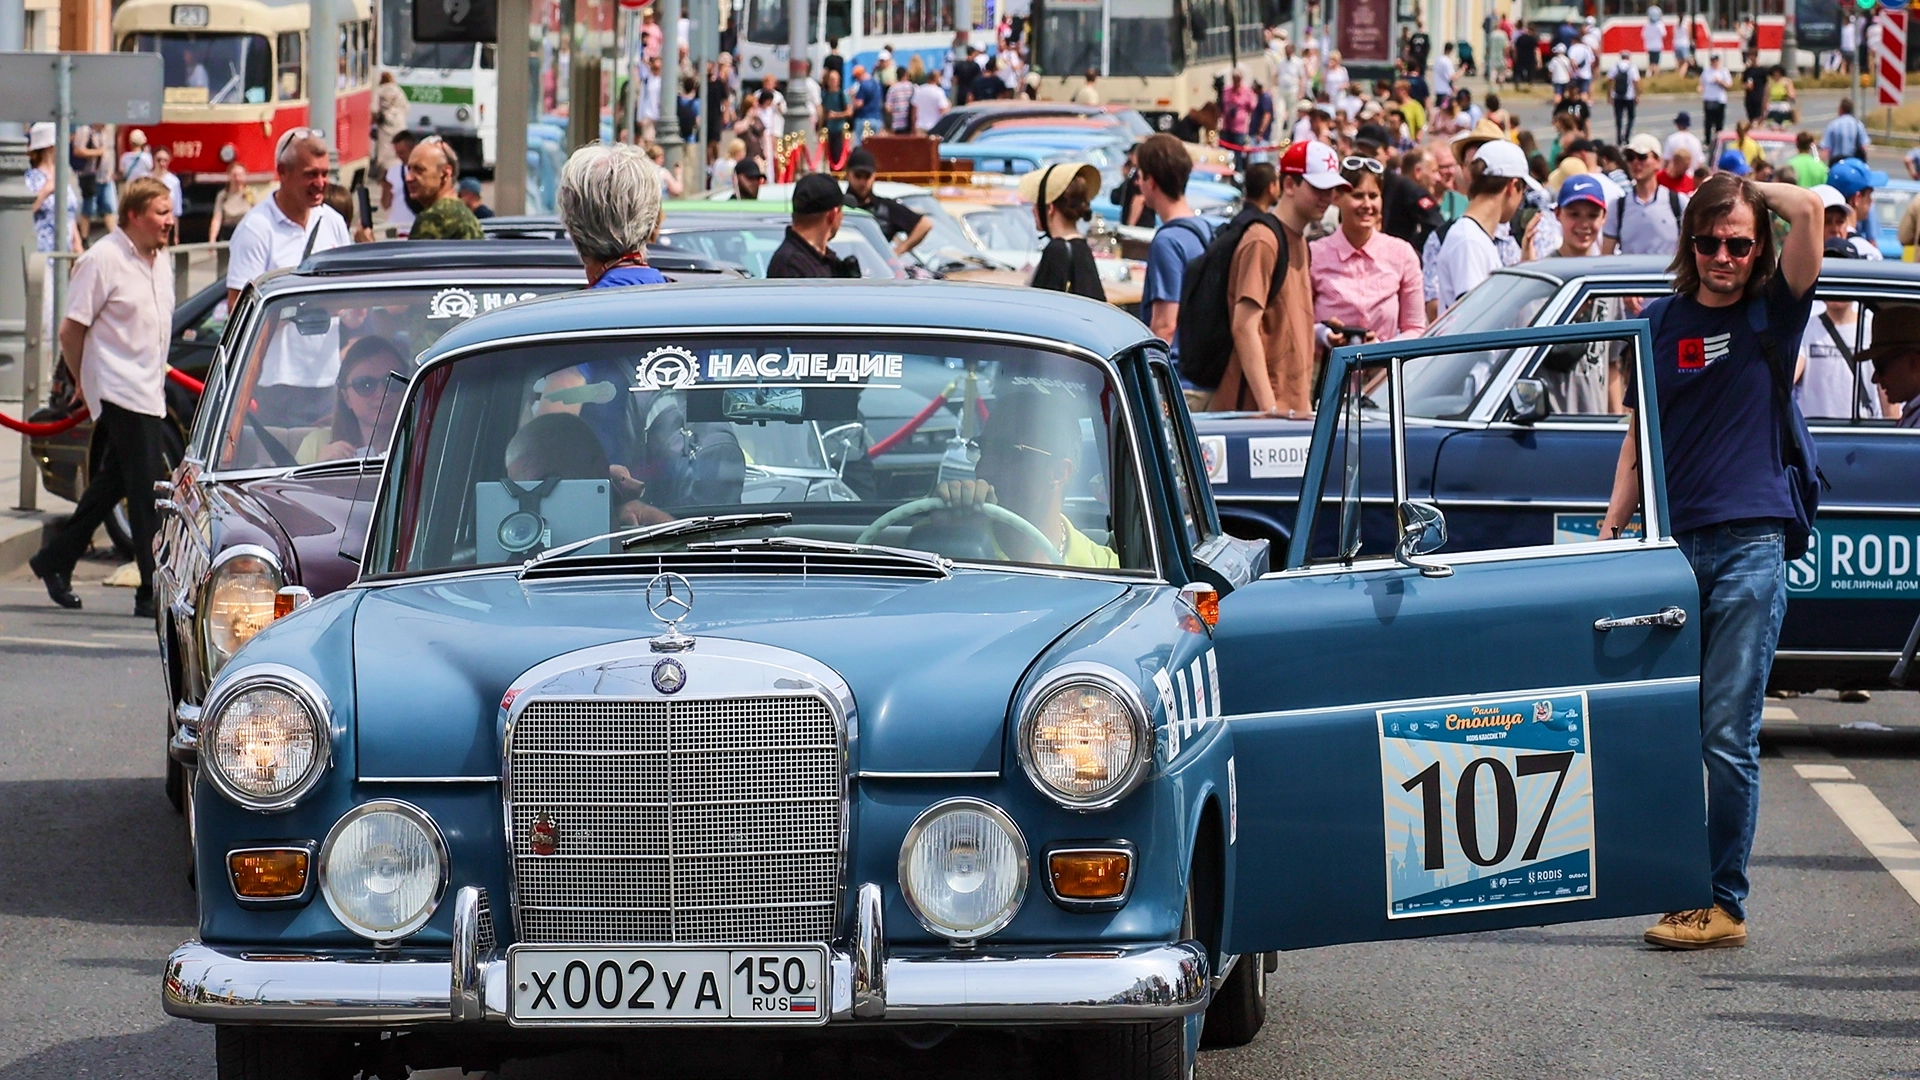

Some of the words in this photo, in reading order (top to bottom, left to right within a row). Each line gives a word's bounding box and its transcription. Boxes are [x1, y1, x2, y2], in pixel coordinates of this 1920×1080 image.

[707, 353, 903, 381] НАСЛЕДИЕ
[1831, 578, 1893, 590] ЮВЕЛИРНЫЙ
[1895, 579, 1919, 591] ДОМ
[1471, 706, 1500, 716] Ралли
[1445, 713, 1524, 731] Столица
[1401, 751, 1575, 870] 107
[1537, 869, 1563, 880] RODIS
[733, 956, 806, 995] 150
[752, 997, 788, 1011] RUS
